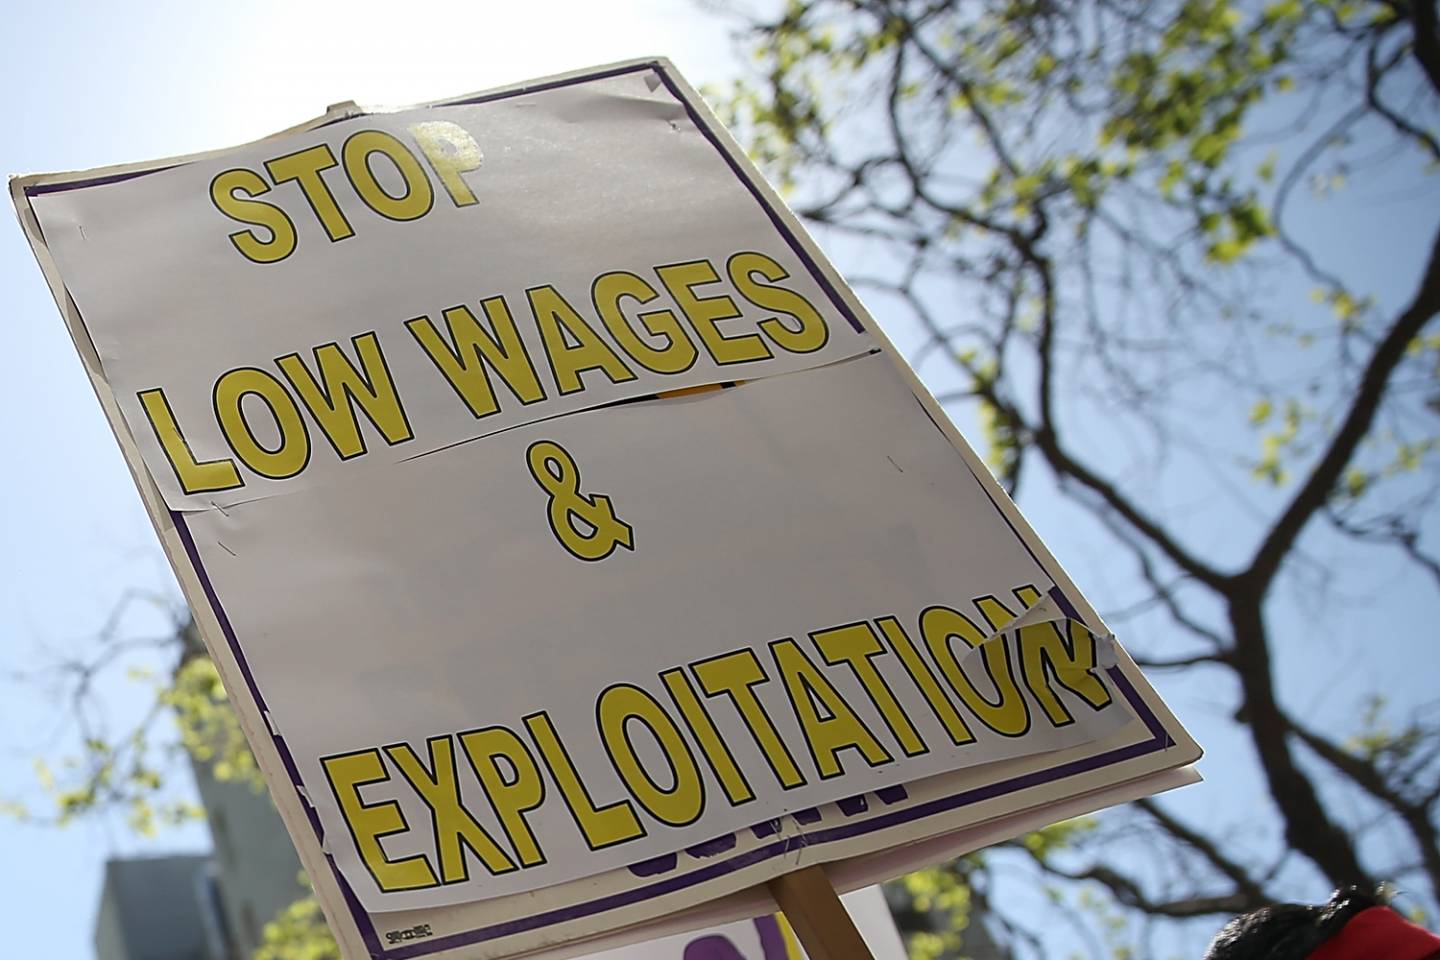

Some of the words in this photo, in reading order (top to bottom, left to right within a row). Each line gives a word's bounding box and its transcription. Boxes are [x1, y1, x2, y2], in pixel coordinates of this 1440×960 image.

[210, 120, 485, 264] STOP
[136, 331, 415, 496] LOW
[406, 251, 831, 420] WAGES
[525, 440, 635, 562] &
[319, 583, 1113, 895] EXPLOITATION
